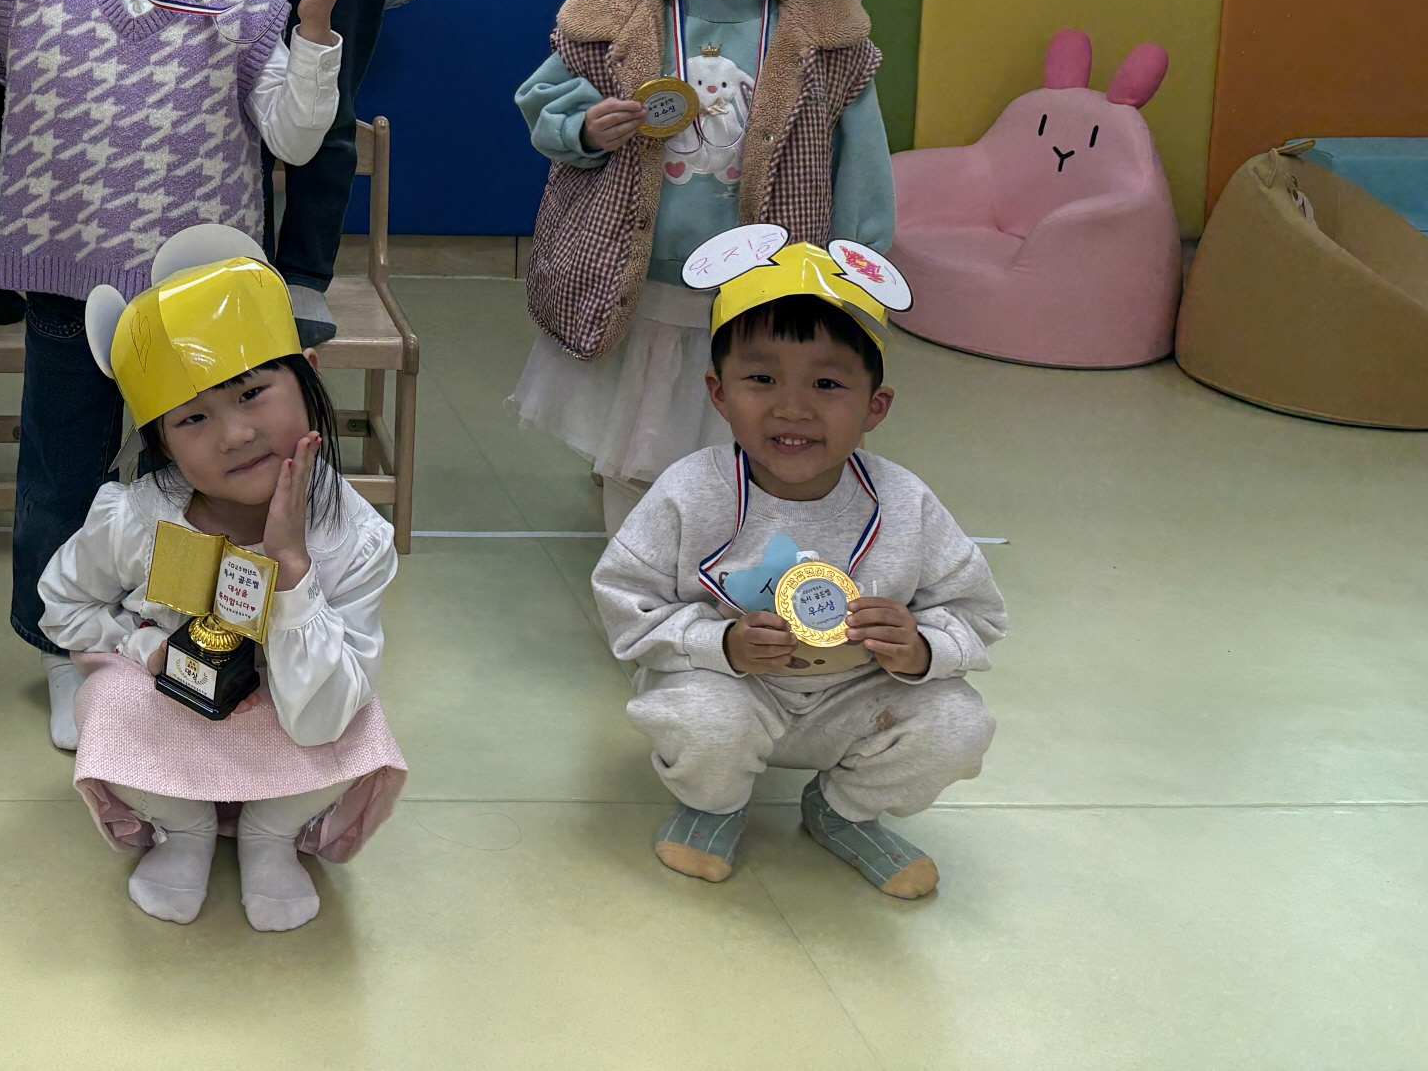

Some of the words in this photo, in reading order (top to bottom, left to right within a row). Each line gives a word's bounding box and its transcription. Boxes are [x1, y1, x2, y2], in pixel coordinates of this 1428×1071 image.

[224, 568, 235, 580] 독서
[238, 575, 259, 589] 골든벨
[228, 584, 249, 598] 대상을
[808, 600, 836, 616] 우수상
